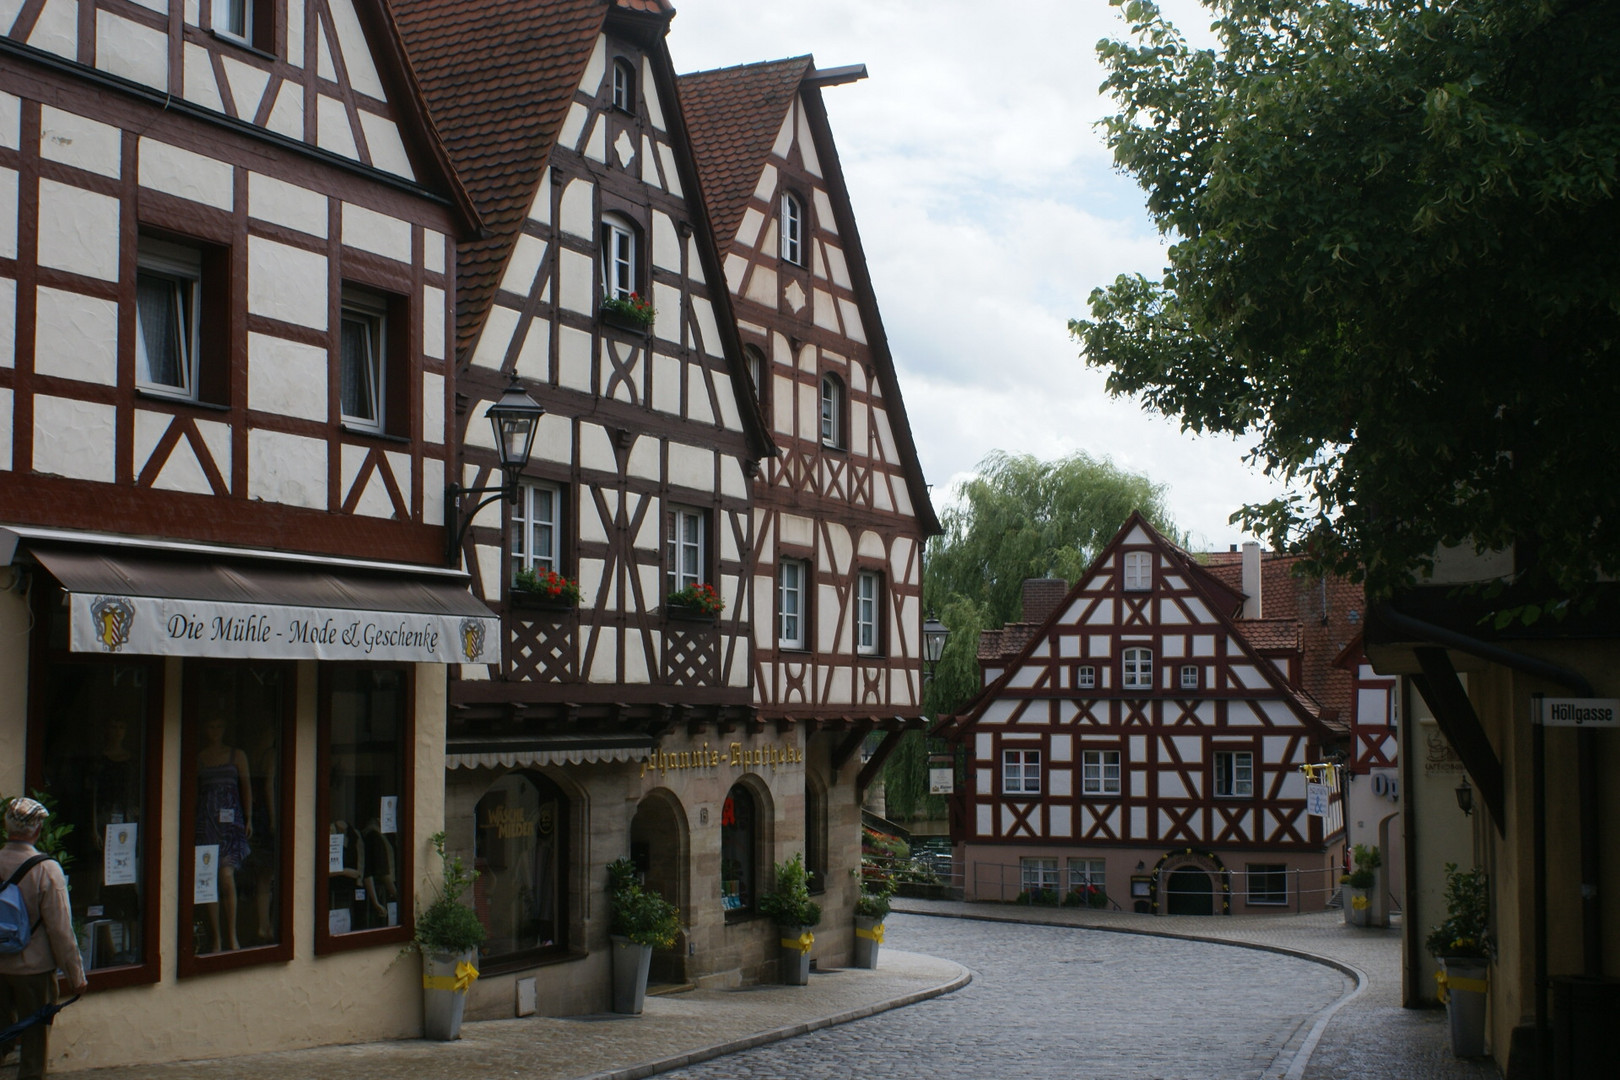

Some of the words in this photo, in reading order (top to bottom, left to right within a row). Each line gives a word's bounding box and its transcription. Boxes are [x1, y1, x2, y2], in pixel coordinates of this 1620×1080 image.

[167, 613, 204, 639] Die
[211, 615, 271, 644] Mühle
[289, 619, 336, 645] Mode
[363, 623, 439, 653] Geschenke
[1551, 704, 1613, 724] Höllgasse
